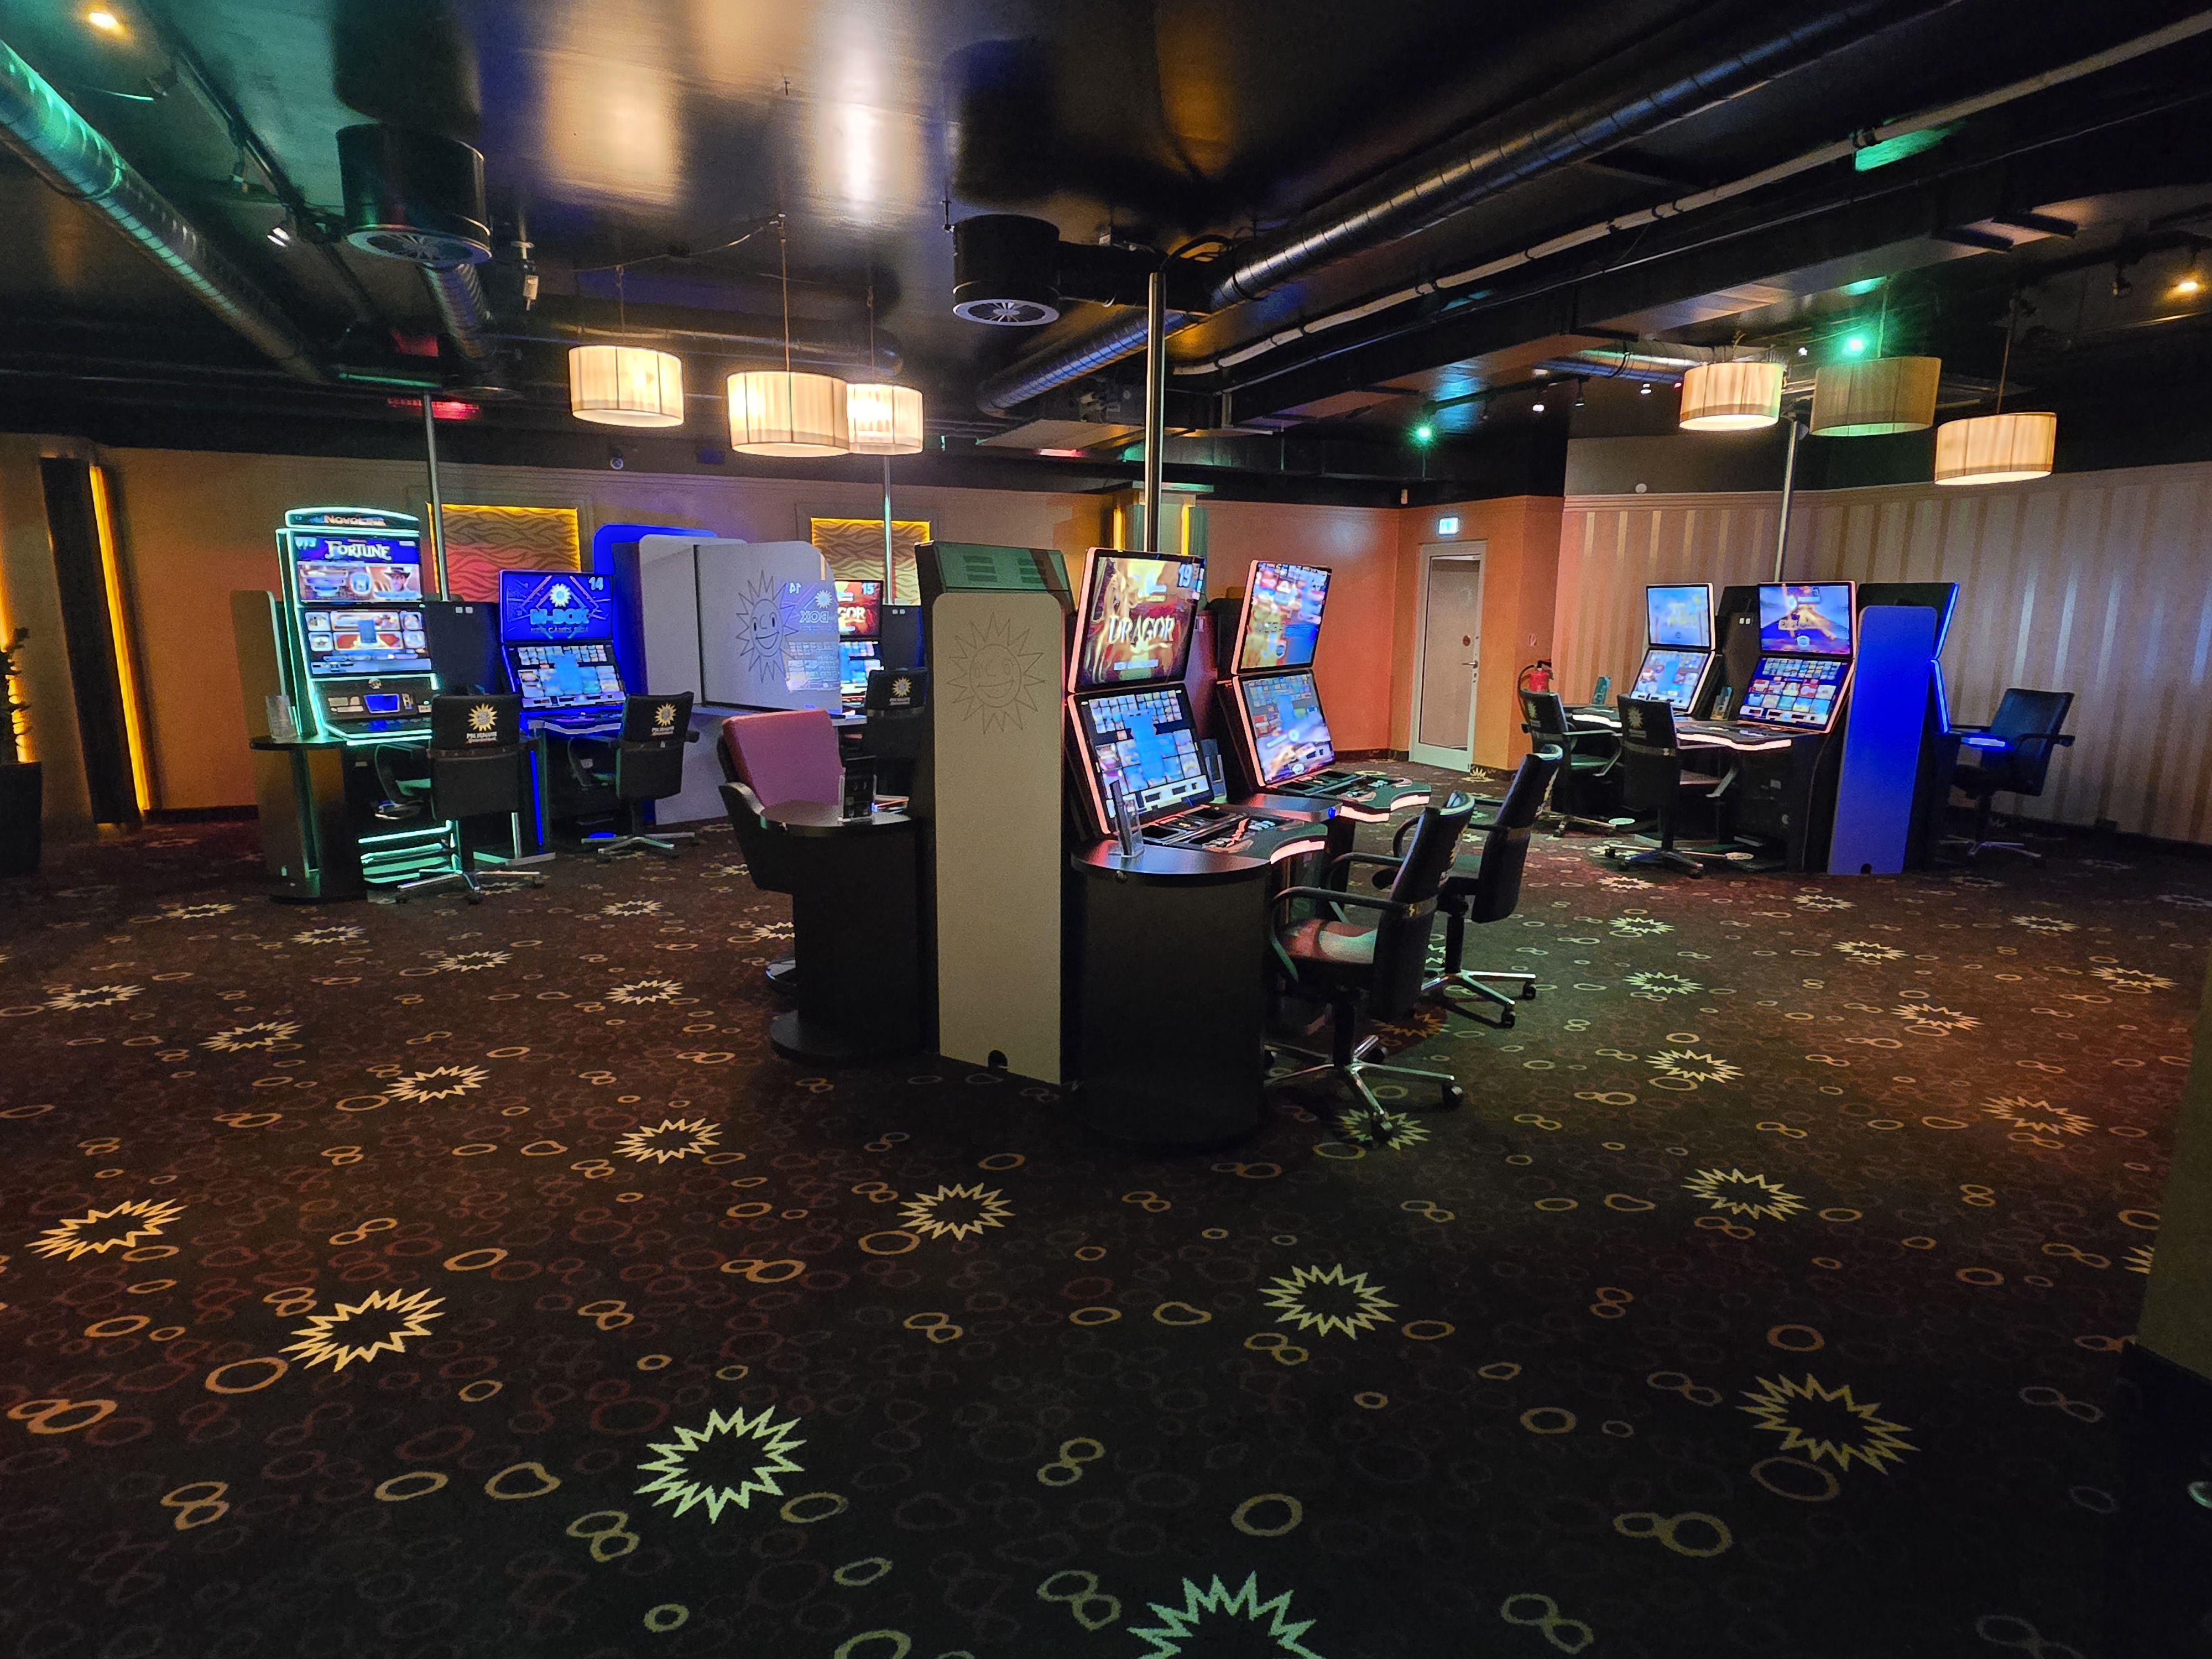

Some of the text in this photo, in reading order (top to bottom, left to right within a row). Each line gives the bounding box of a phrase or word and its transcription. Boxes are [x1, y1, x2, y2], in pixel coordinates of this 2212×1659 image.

[325, 540, 392, 561] FORTUNE
[589, 577, 603, 591] 14
[1178, 564, 1193, 587] 19
[862, 583, 875, 595] 15
